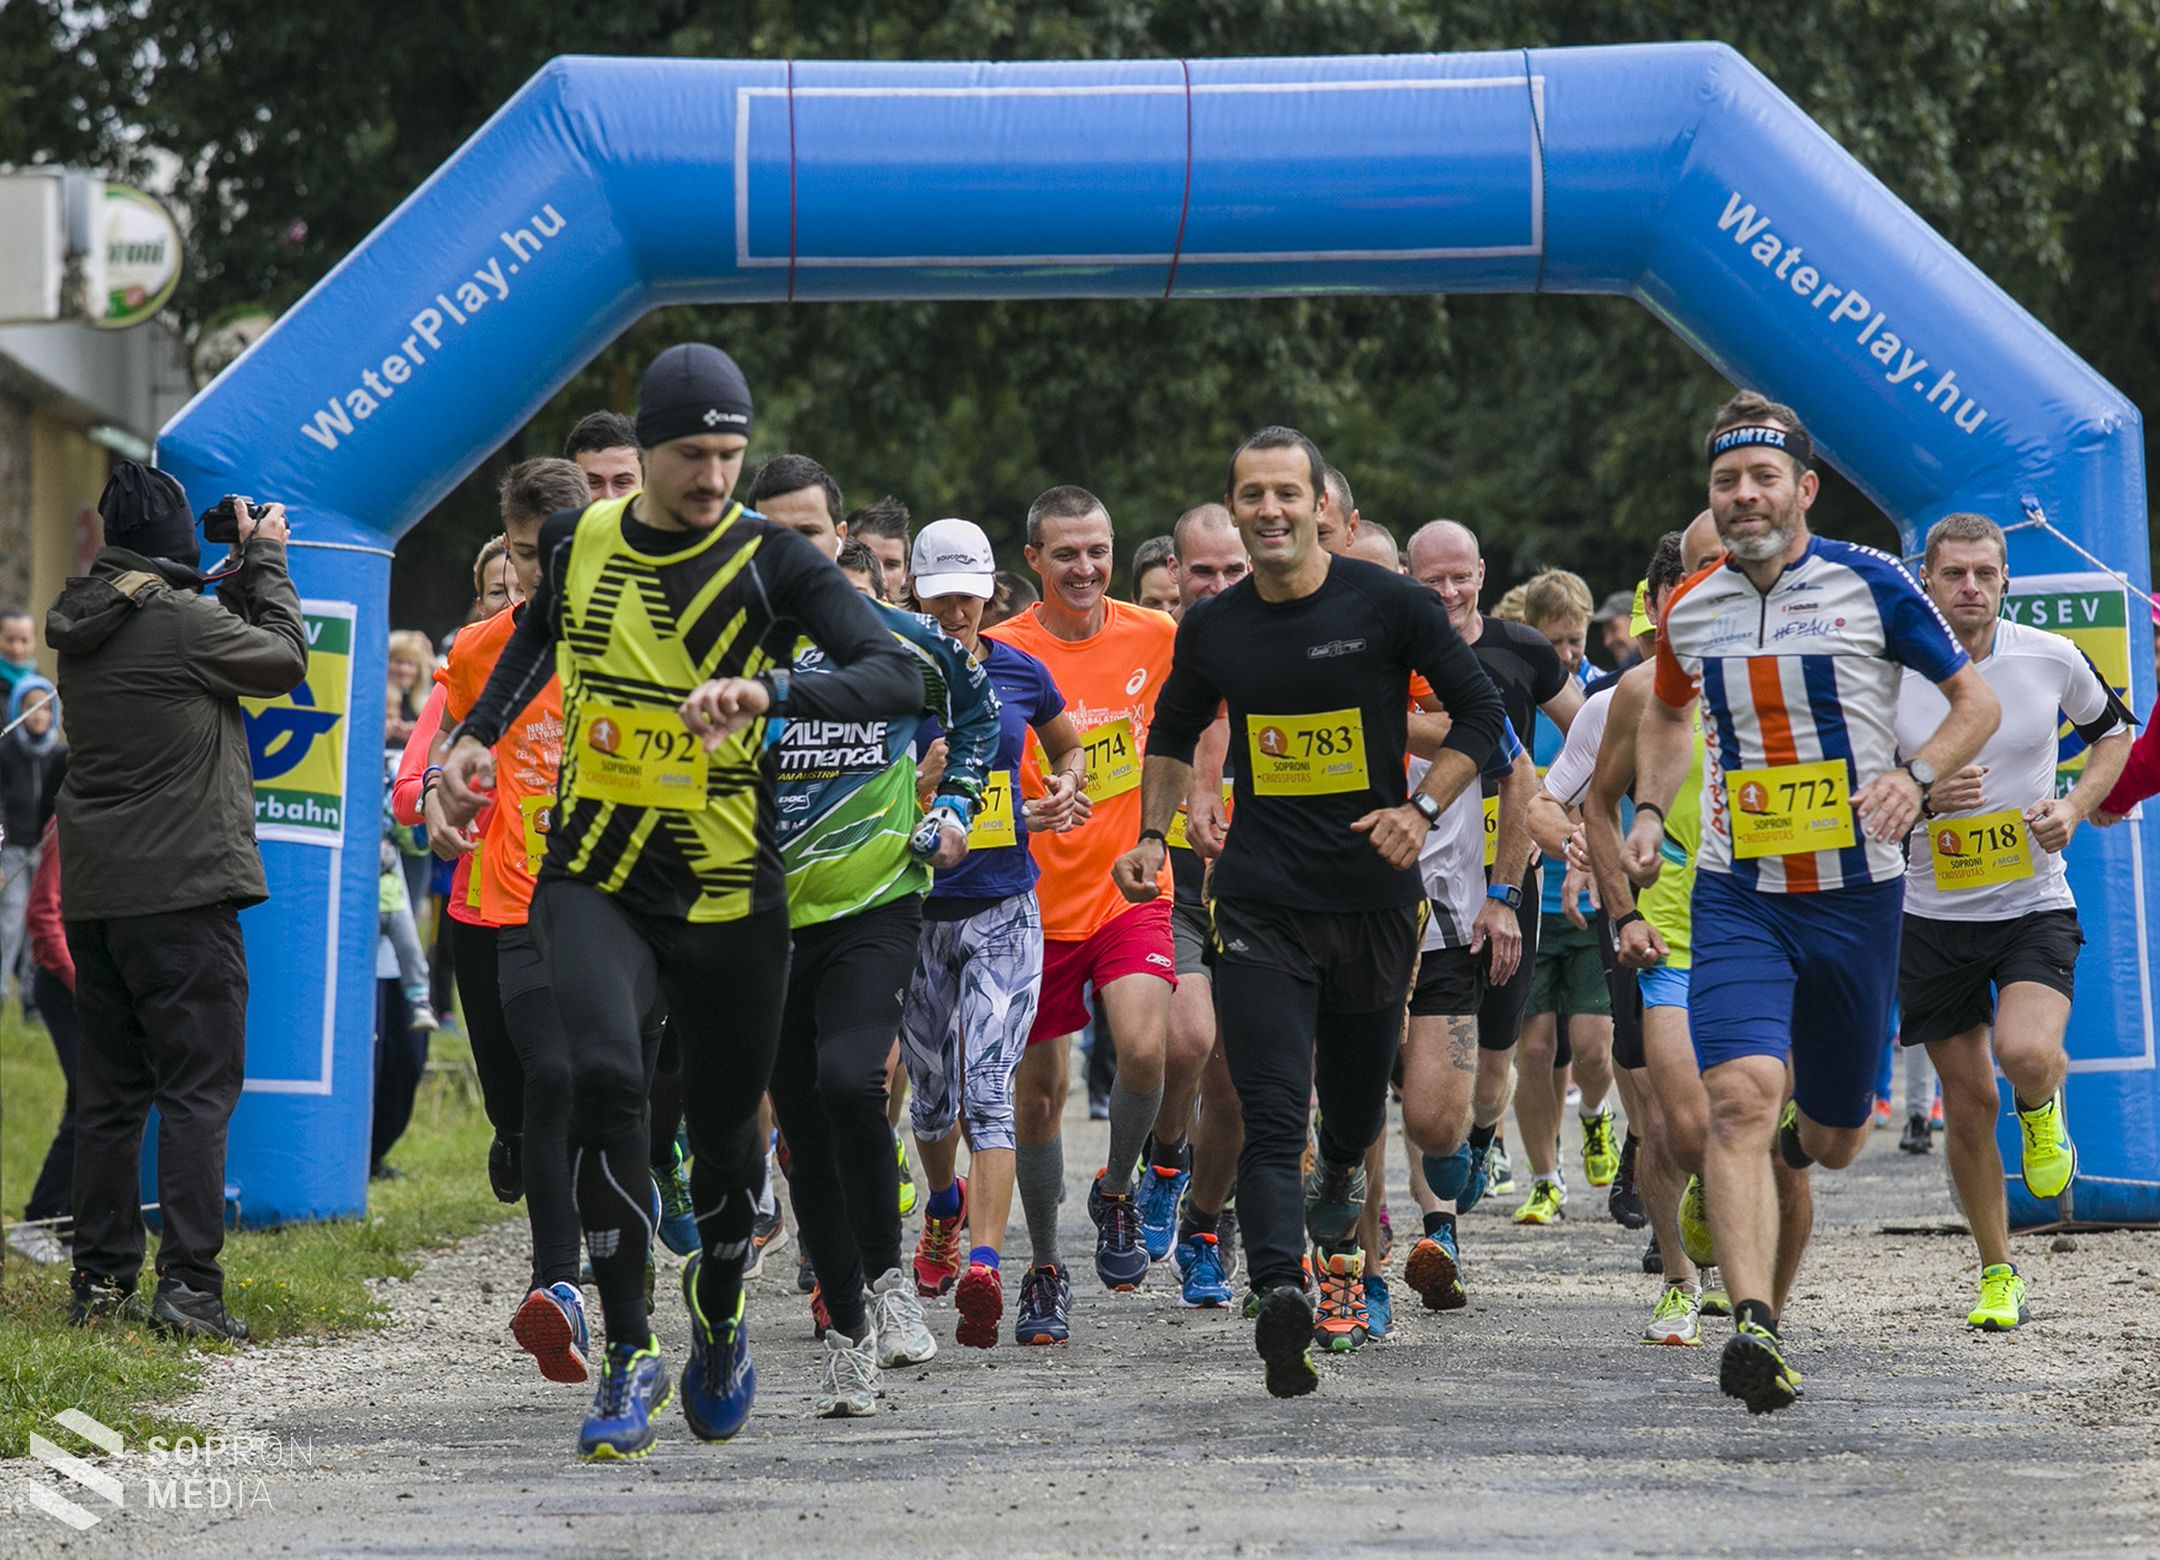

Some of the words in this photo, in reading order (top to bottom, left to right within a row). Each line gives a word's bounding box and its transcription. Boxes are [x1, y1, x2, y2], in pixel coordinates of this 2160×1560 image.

[301, 204, 567, 451] WaterPlay.hu
[1718, 192, 1988, 434] WaterPlay.hu
[1714, 427, 1786, 453] TRIMTEX
[2004, 597, 2099, 625] YSEV
[634, 728, 695, 762] 792
[780, 718, 888, 746] ALPINE
[1297, 726, 1352, 757] 783
[1084, 732, 1127, 769] 774
[1273, 761, 1311, 772] SOPRONI
[254, 794, 339, 825] rbahn
[1779, 778, 1837, 812] 772
[1753, 817, 1793, 831] SOPRONI
[1968, 823, 2018, 854] 718
[1950, 857, 1983, 870] SOPRONI
